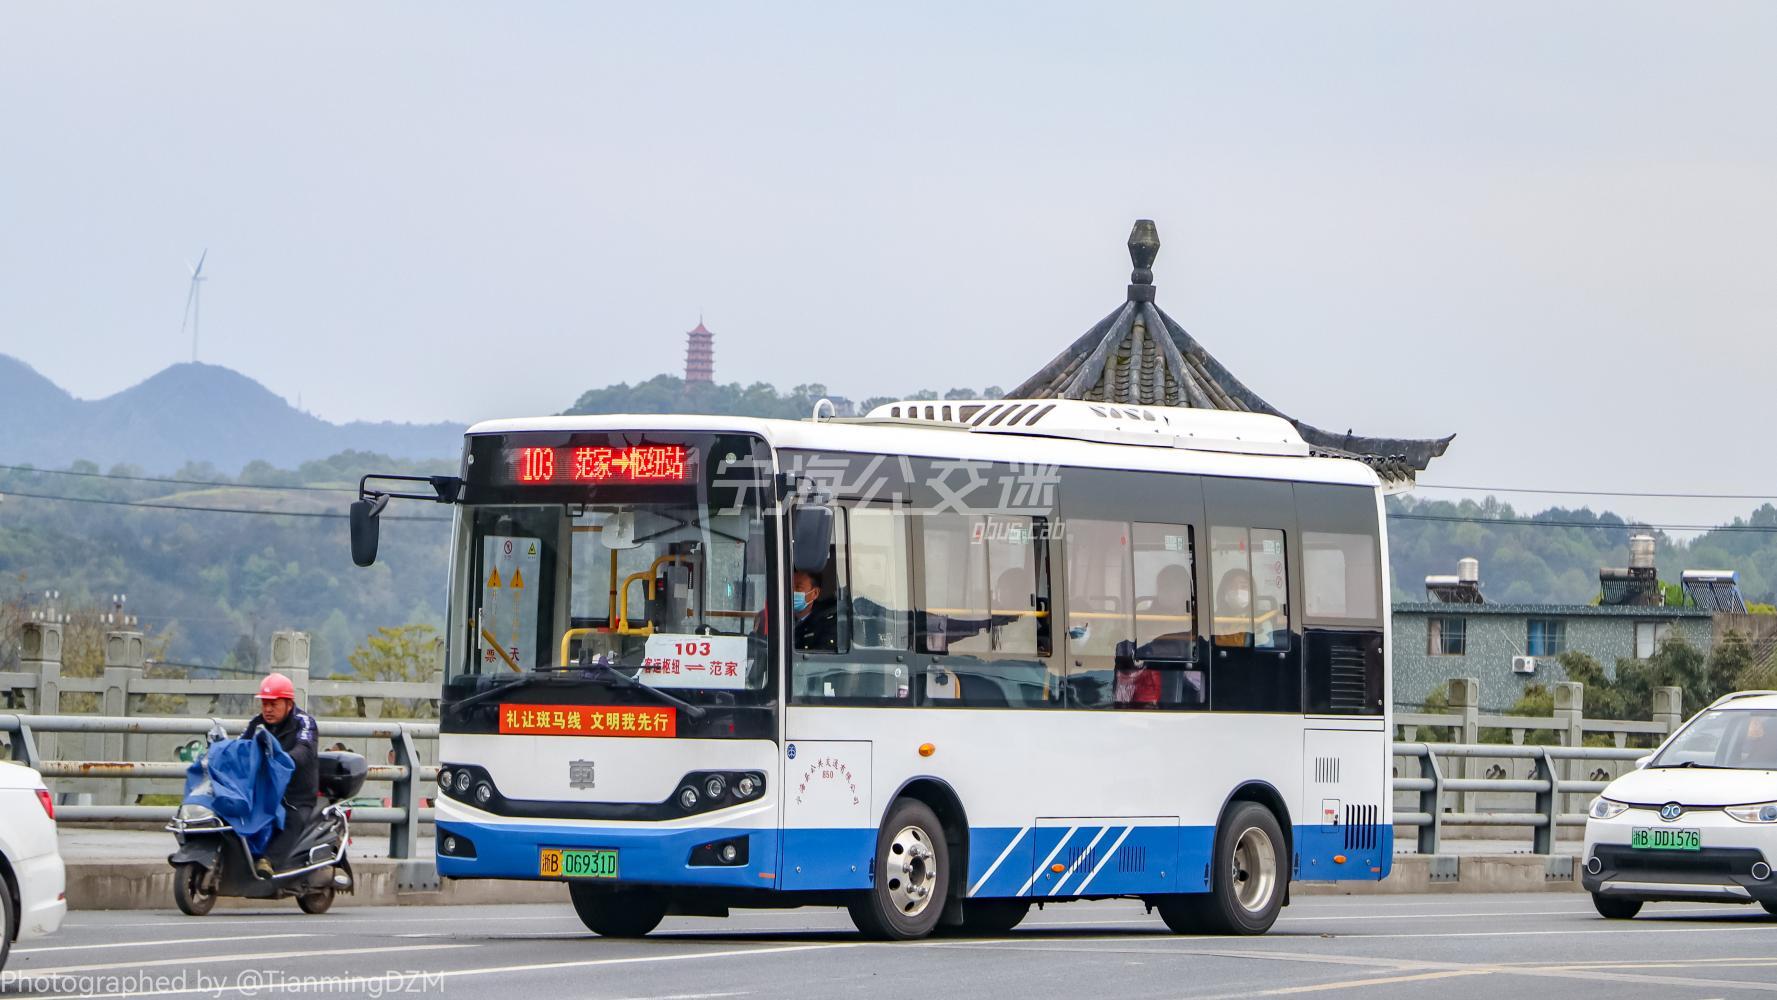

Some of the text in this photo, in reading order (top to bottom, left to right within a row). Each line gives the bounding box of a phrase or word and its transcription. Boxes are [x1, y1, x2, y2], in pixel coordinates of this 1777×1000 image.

[523, 448, 554, 481] 103
[675, 642, 712, 657] 103
[644, 657, 739, 677] 客运枢纽 范家
[506, 709, 669, 732] 礼让斑马线 文明我先行
